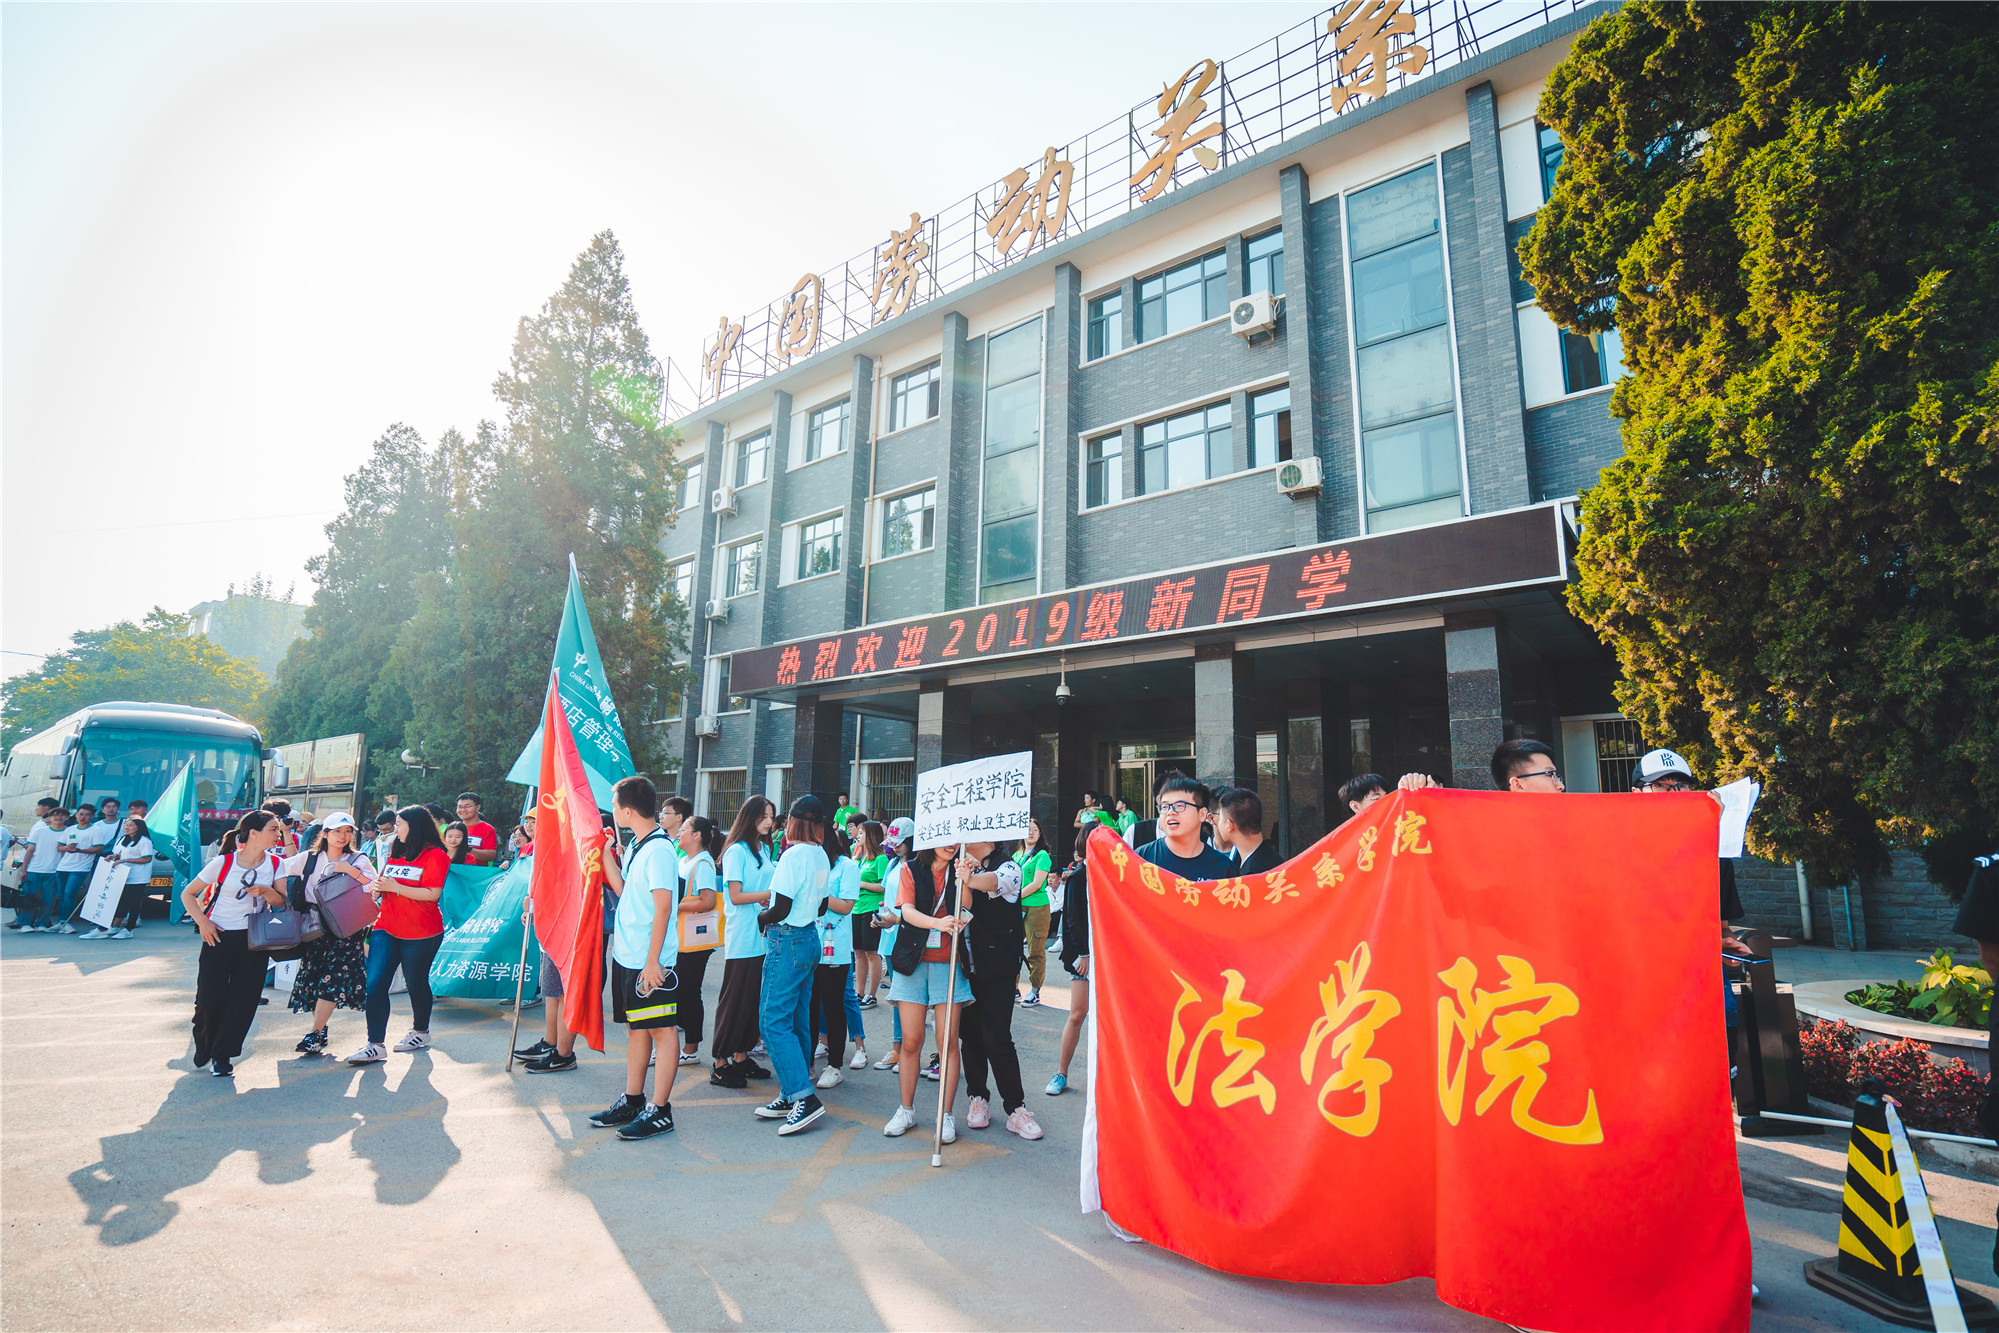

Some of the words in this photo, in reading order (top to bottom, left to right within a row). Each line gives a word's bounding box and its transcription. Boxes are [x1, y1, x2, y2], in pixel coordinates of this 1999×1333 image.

[775, 549, 1352, 686] 热烈欢迎2019级新同学
[569, 670, 586, 687] CHINA
[920, 768, 1027, 815] 安全工程学院
[917, 820, 952, 841] 安全工程
[956, 810, 1029, 832] 职业卫生工程
[1109, 811, 1432, 909] 中国劳动关系学院
[431, 959, 533, 982] 人力资源学院
[1166, 941, 1604, 1145] 法学院
